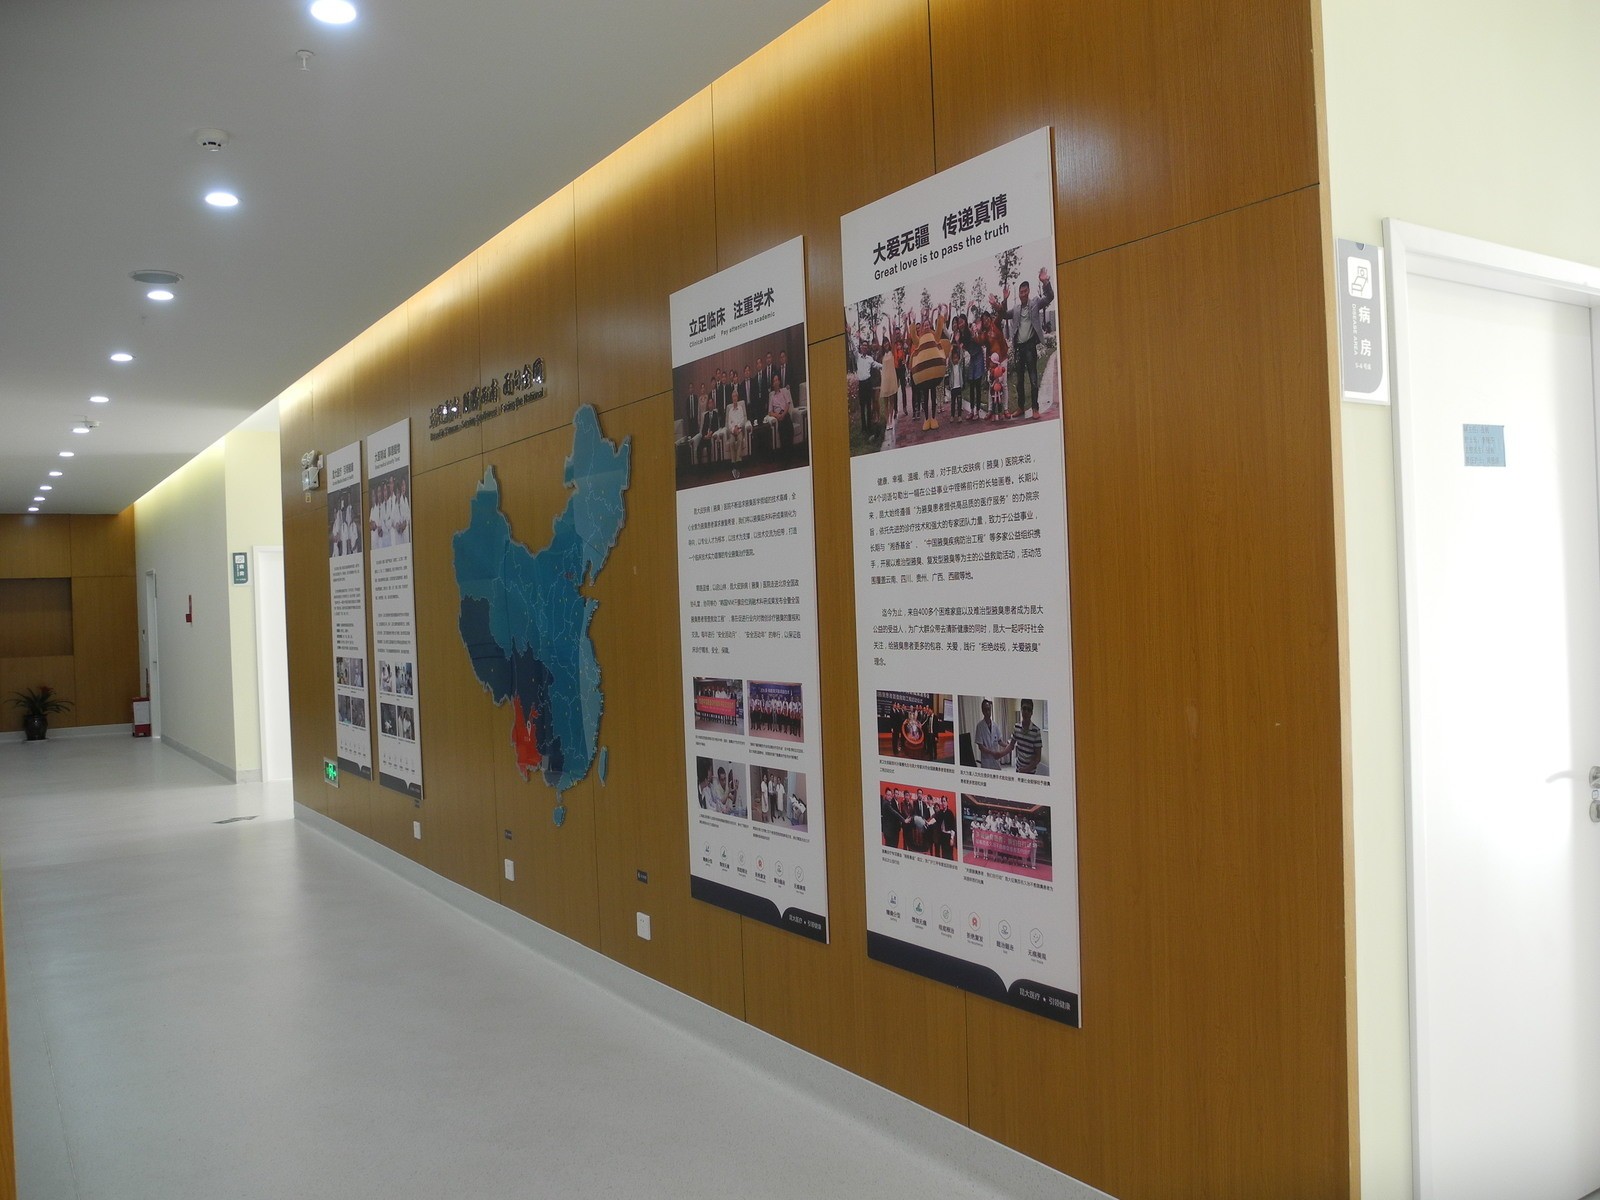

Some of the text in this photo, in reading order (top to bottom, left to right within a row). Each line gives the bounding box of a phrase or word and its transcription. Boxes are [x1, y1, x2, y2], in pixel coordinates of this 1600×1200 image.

[873, 193, 1008, 266] 大爱无疆 传递真情
[874, 222, 1010, 281] Great love is to pass the truth
[689, 287, 775, 338] 立足临床 注重学术
[689, 337, 703, 348] Clinical
[704, 333, 716, 343] based
[720, 328, 728, 336] Pay
[729, 321, 748, 333] attention
[754, 312, 776, 324] academic
[1358, 305, 1372, 357] 病房
[1019, 987, 1071, 1011] 昆大医疗 引领健康
